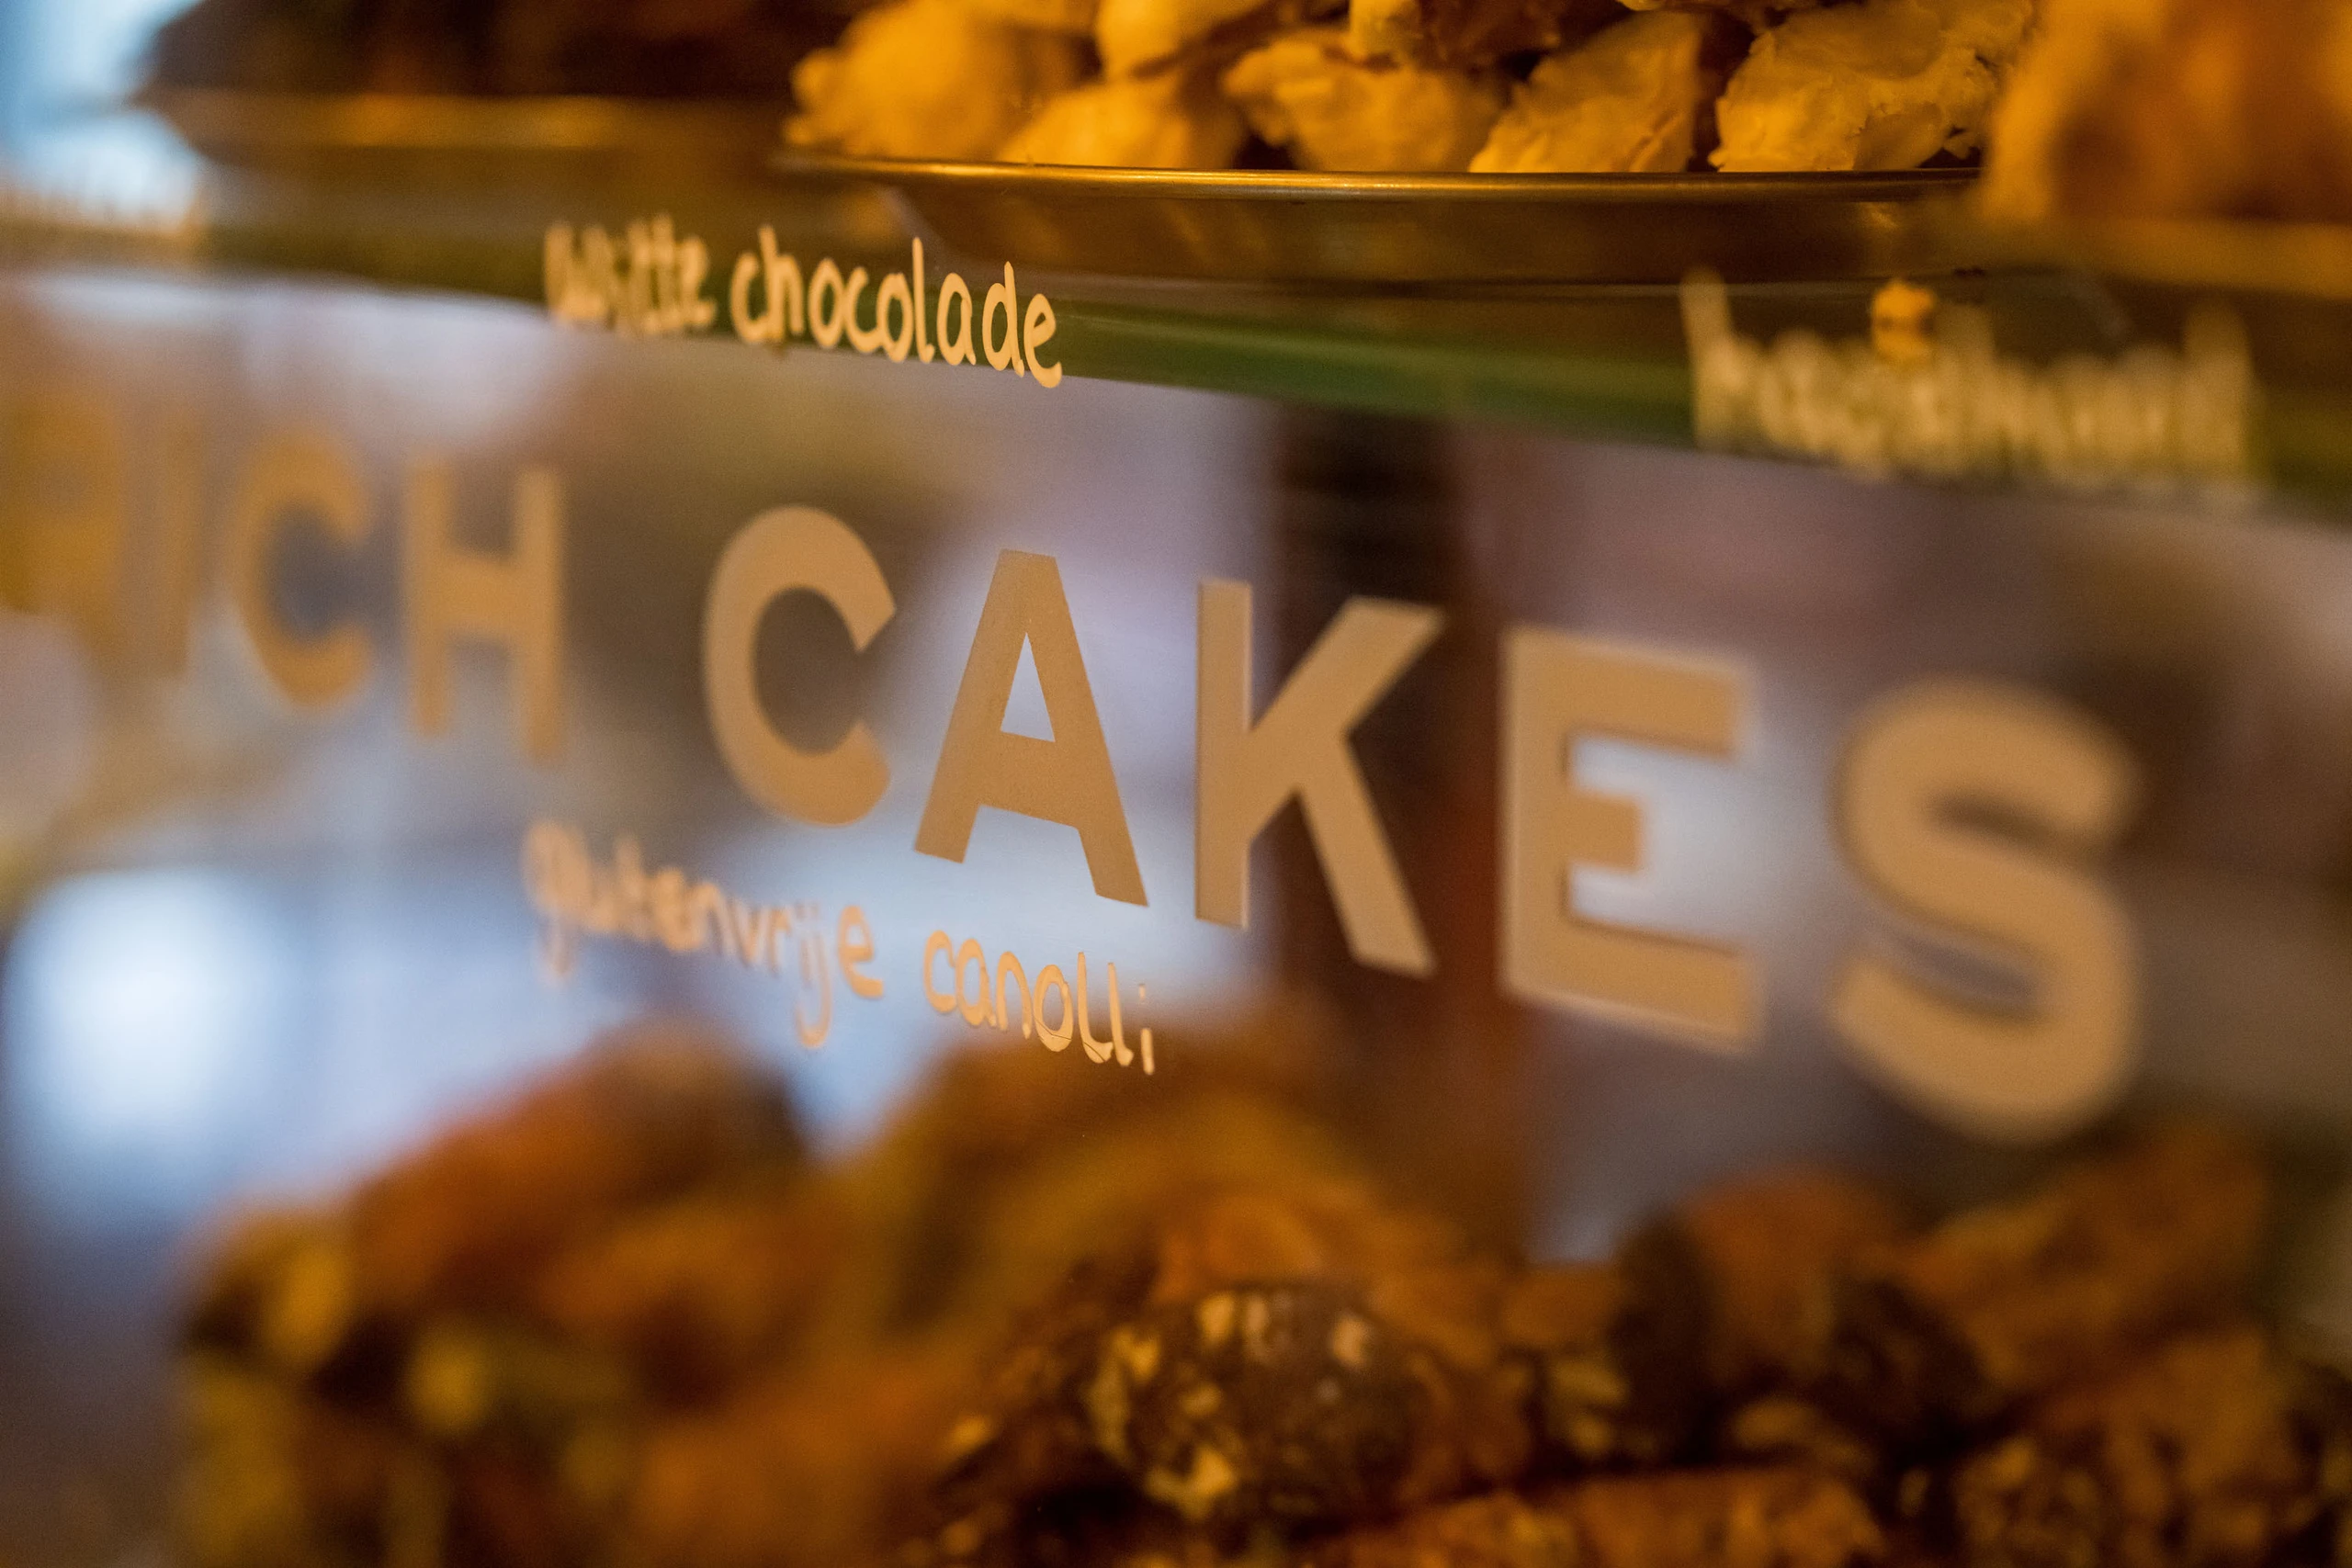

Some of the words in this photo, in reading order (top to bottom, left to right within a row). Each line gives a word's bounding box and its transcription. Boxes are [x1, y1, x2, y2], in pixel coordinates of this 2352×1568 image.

[730, 225, 1063, 388] chocolade
[704, 505, 2141, 1141] CAKES
[923, 931, 1156, 1075] canolli
